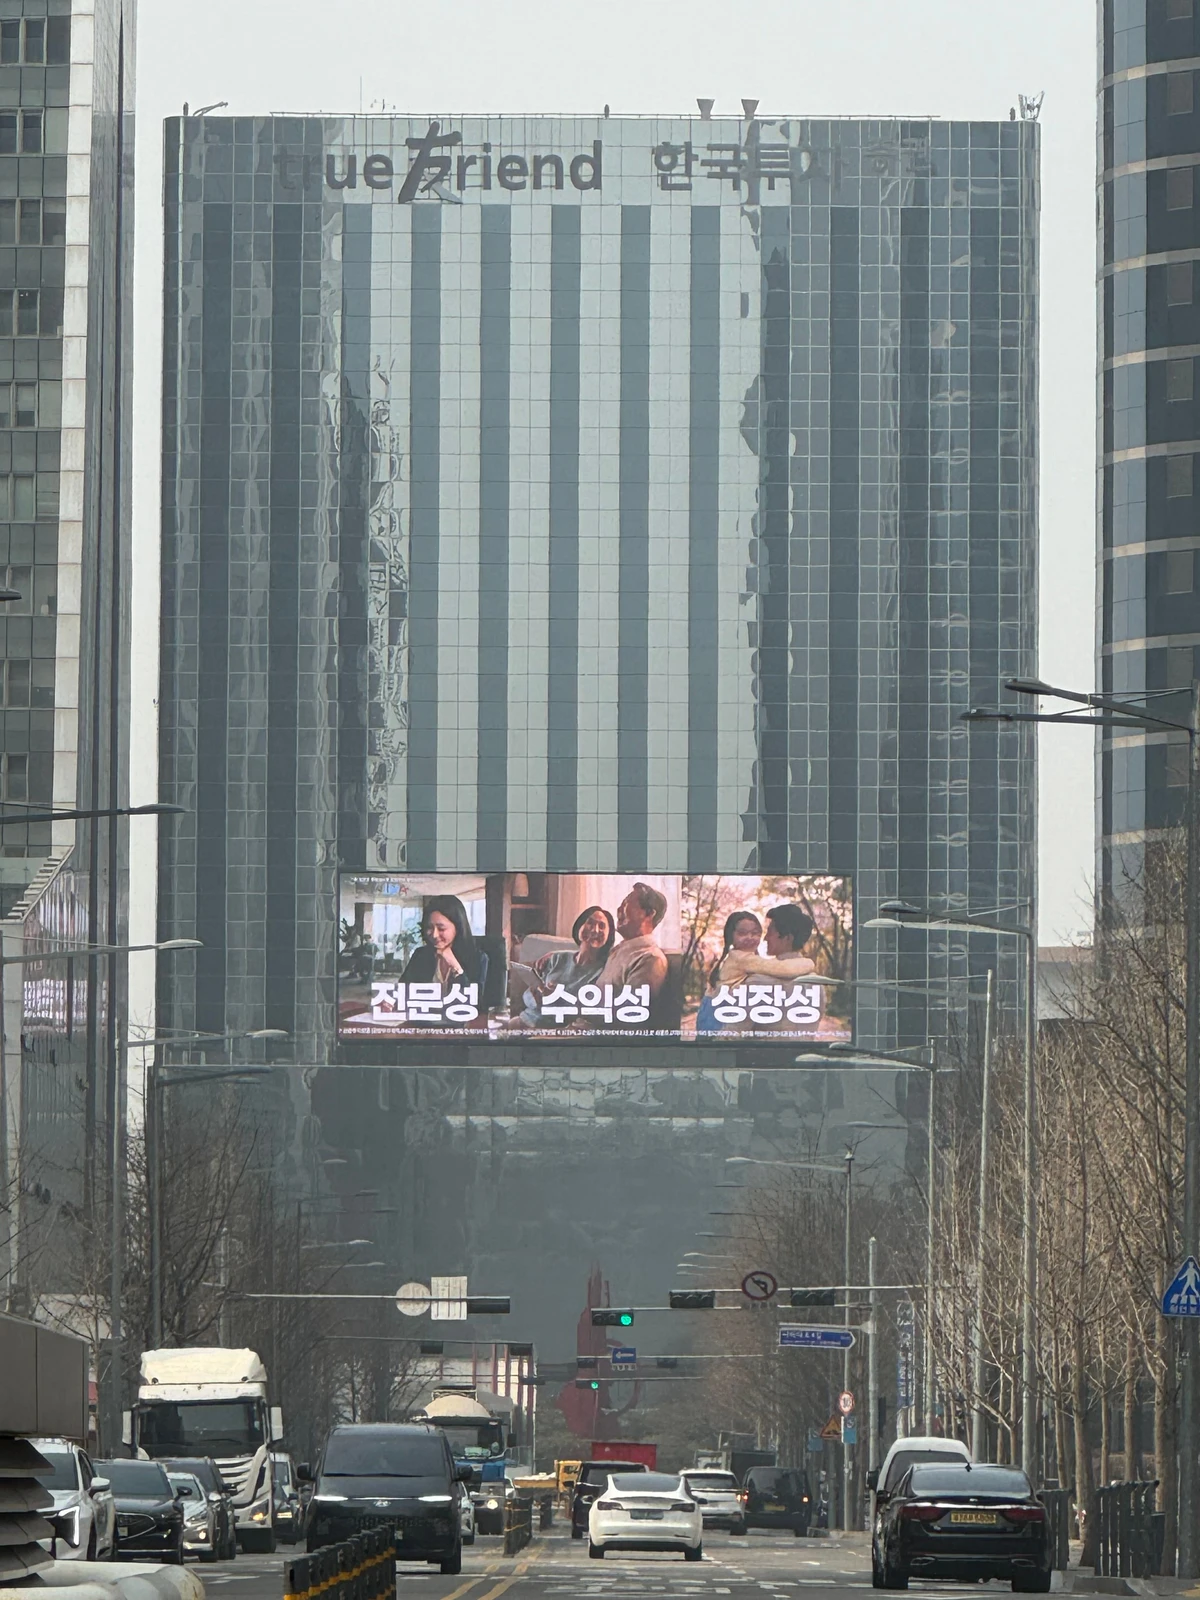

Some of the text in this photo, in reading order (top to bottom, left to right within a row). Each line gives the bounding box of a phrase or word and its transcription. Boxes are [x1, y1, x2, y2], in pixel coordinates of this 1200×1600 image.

[371, 982, 479, 1022] 전문성
[541, 983, 650, 1024] 수익성
[711, 984, 820, 1024] 성장성
